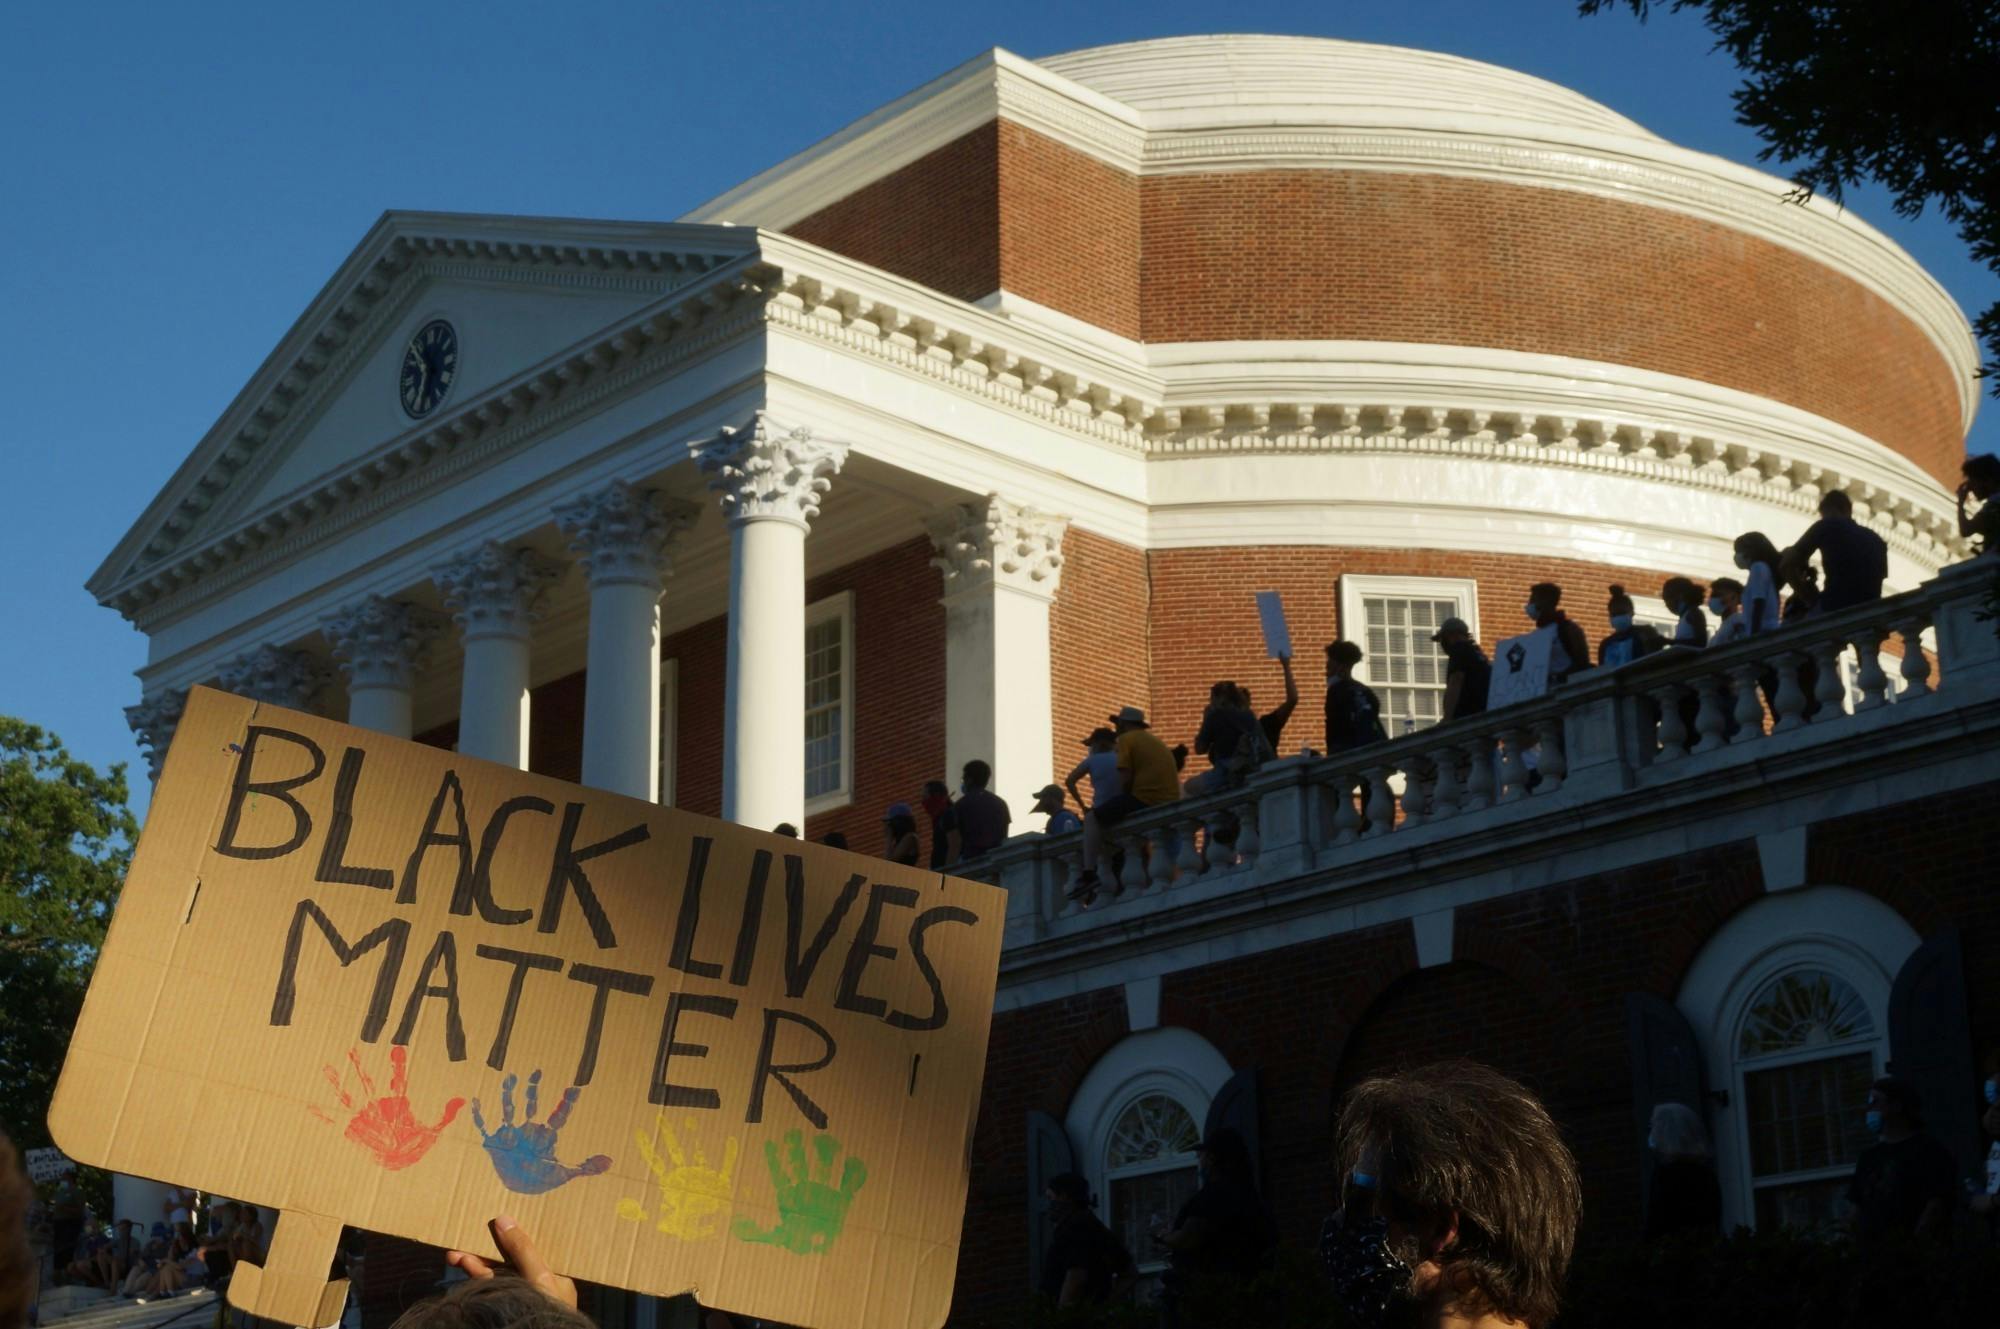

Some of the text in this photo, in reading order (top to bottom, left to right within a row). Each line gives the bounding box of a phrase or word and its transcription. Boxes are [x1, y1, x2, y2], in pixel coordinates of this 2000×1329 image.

[213, 726, 979, 1031] BLACK LIVES
[269, 899, 837, 1130] MATTER
